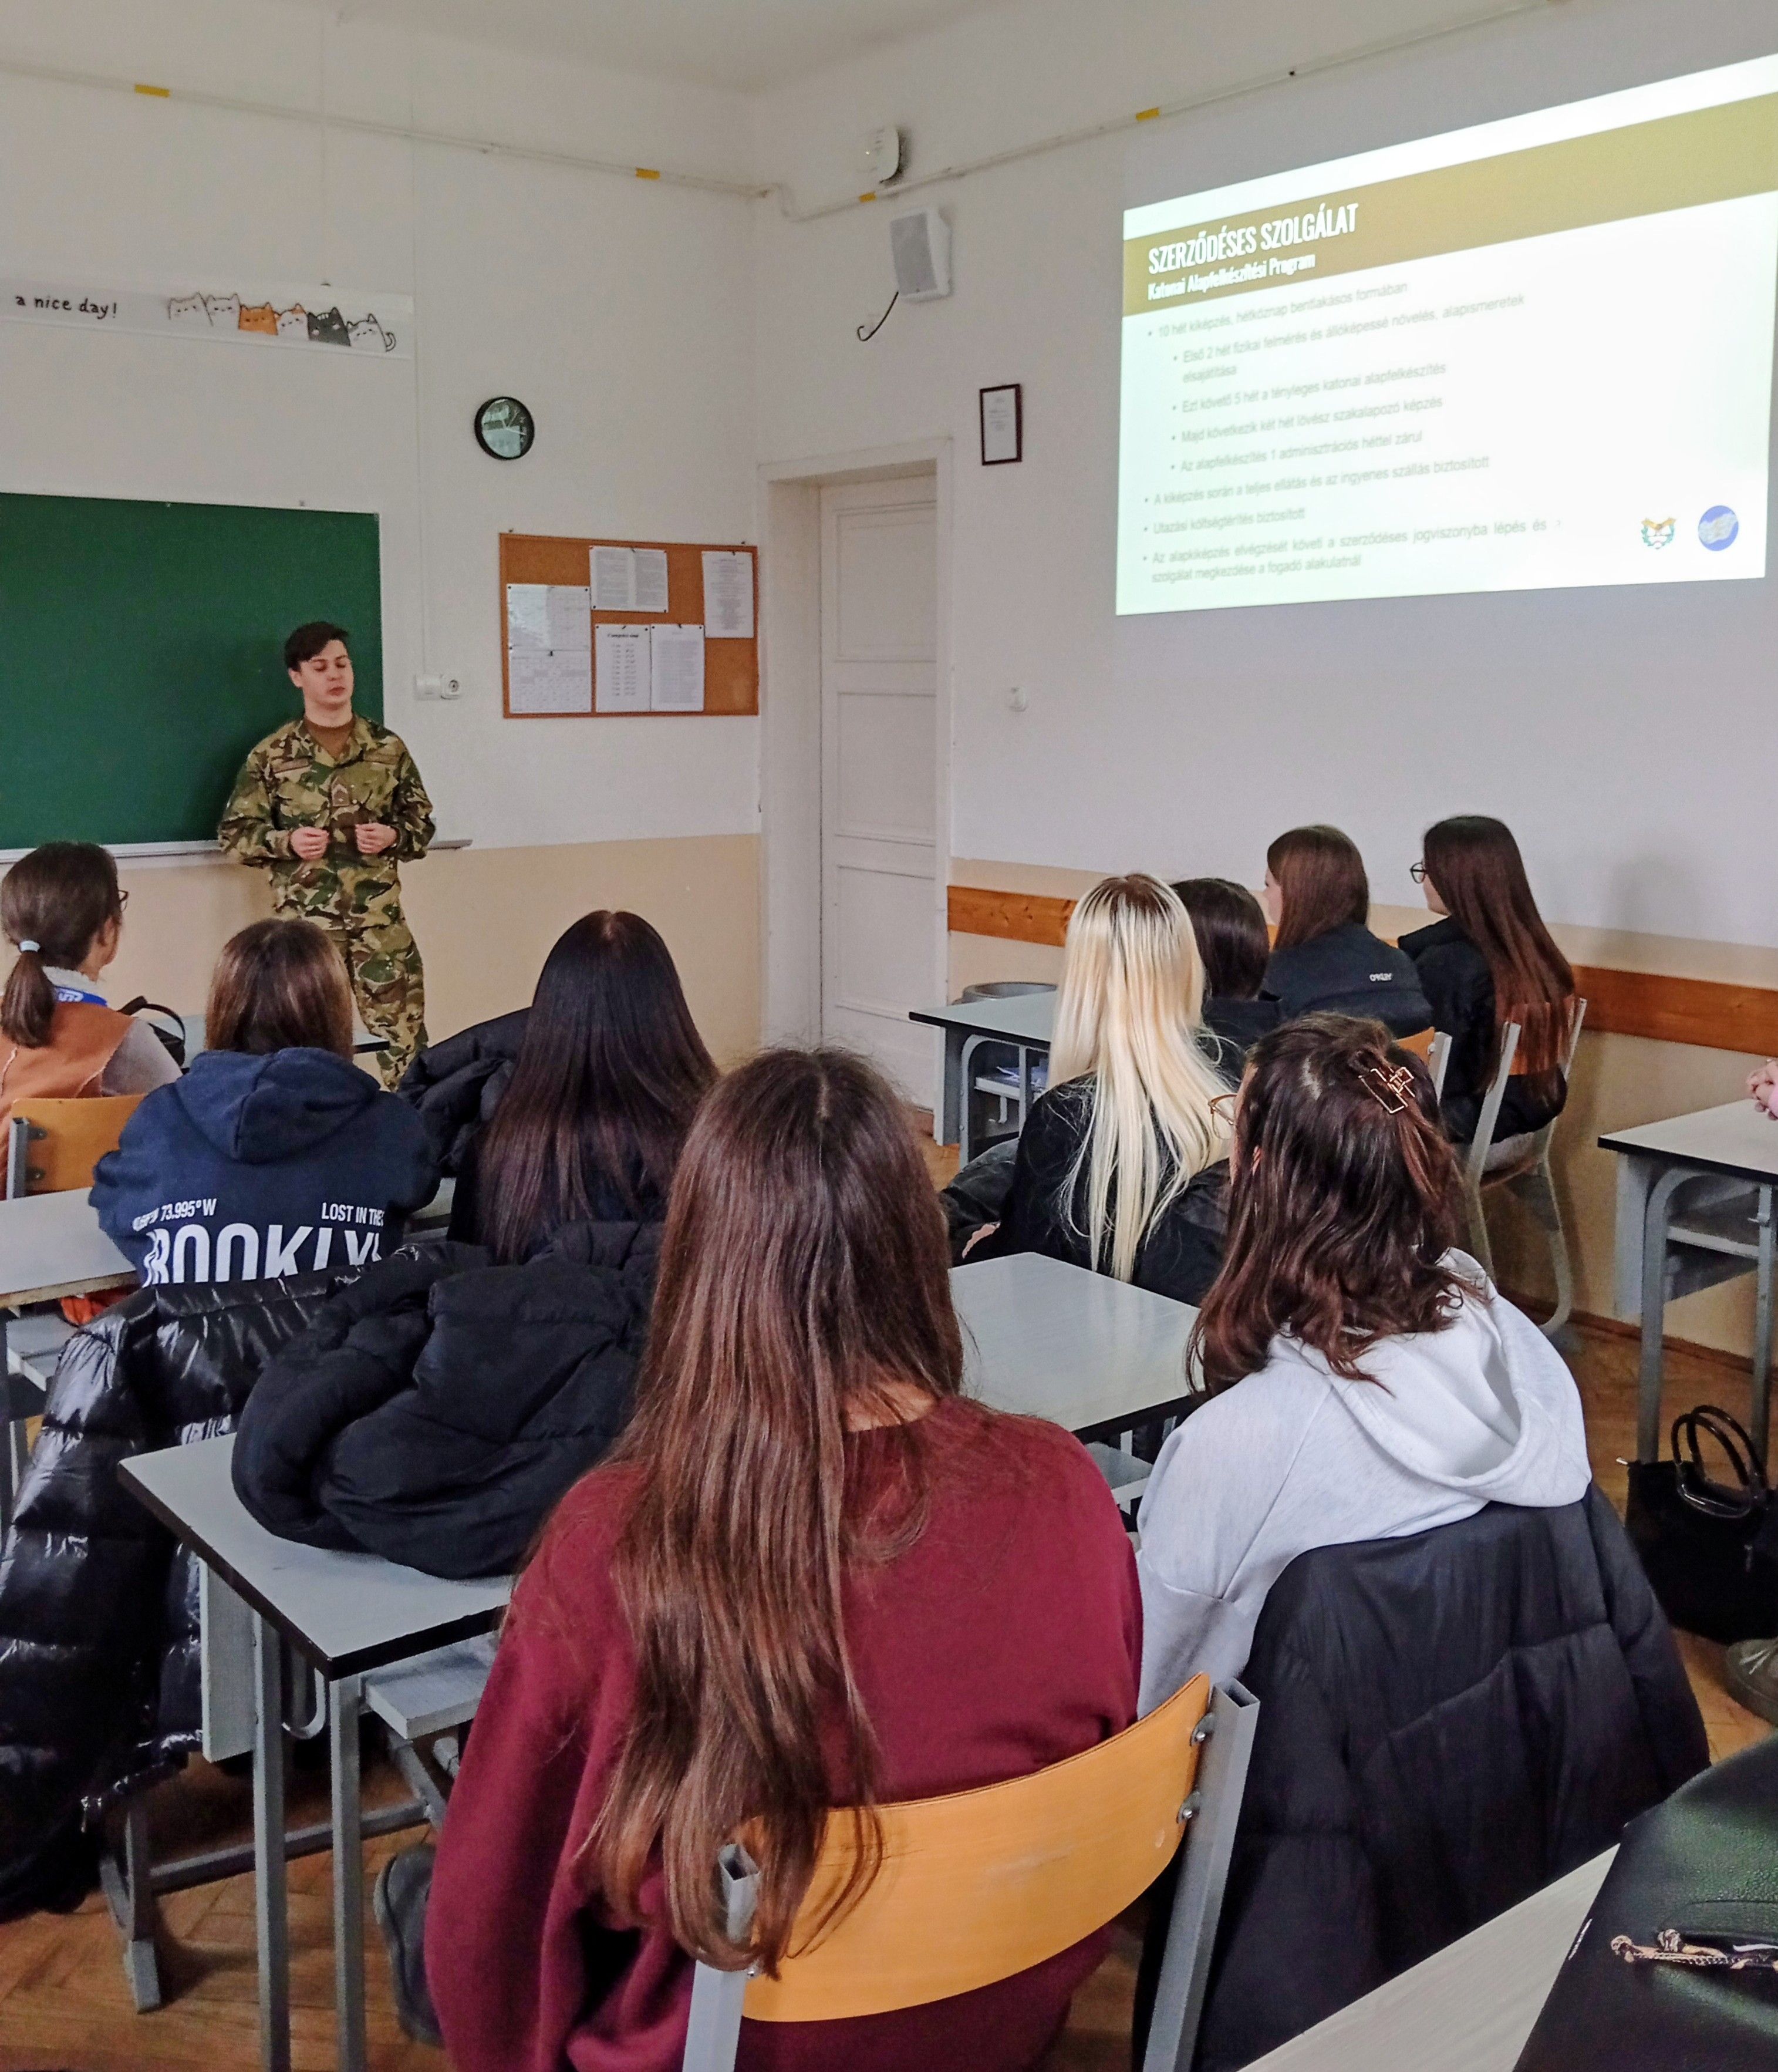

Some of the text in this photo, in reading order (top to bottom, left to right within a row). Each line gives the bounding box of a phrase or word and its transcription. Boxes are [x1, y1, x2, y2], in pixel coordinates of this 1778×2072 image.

[1148, 203, 1359, 275] SZERZŐDÉSES SZOLGÁLAT
[1147, 277, 1186, 301] Katonai
[1268, 253, 1316, 277] Program
[1356, 282, 1408, 302] formában
[15, 295, 117, 319] a nice day!
[1207, 346, 1213, 359] 2
[1310, 328, 1323, 341] és
[1442, 294, 1525, 318] alapismeretek
[1234, 392, 1241, 405] 5
[1261, 391, 1268, 400] a
[1271, 383, 1320, 399] tényleges
[1323, 374, 1362, 392] katonai
[1332, 400, 1400, 422] szakalapozó
[1403, 395, 1443, 413] képzés
[1181, 460, 1193, 472] Az
[1270, 449, 1276, 460] 1
[1361, 433, 1391, 449] héttel
[1395, 430, 1423, 445] zárul
[1153, 494, 1161, 505] A
[1236, 486, 1243, 496] a
[1310, 474, 1322, 487] és
[1325, 474, 1337, 486] az
[1341, 467, 1389, 486] ingyenes
[1392, 462, 1431, 478] szállás
[1433, 456, 1490, 473] biztosított
[1152, 551, 1165, 564] Az
[1327, 538, 1335, 548] a
[1339, 531, 1408, 547] szerződéses
[1412, 524, 1487, 545] jogviszonyba
[1493, 520, 1527, 537] lépés
[1532, 518, 1547, 532] és
[1259, 564, 1265, 574] a
[321, 1202, 354, 1222] LOST
[355, 1206, 367, 1224] IN
